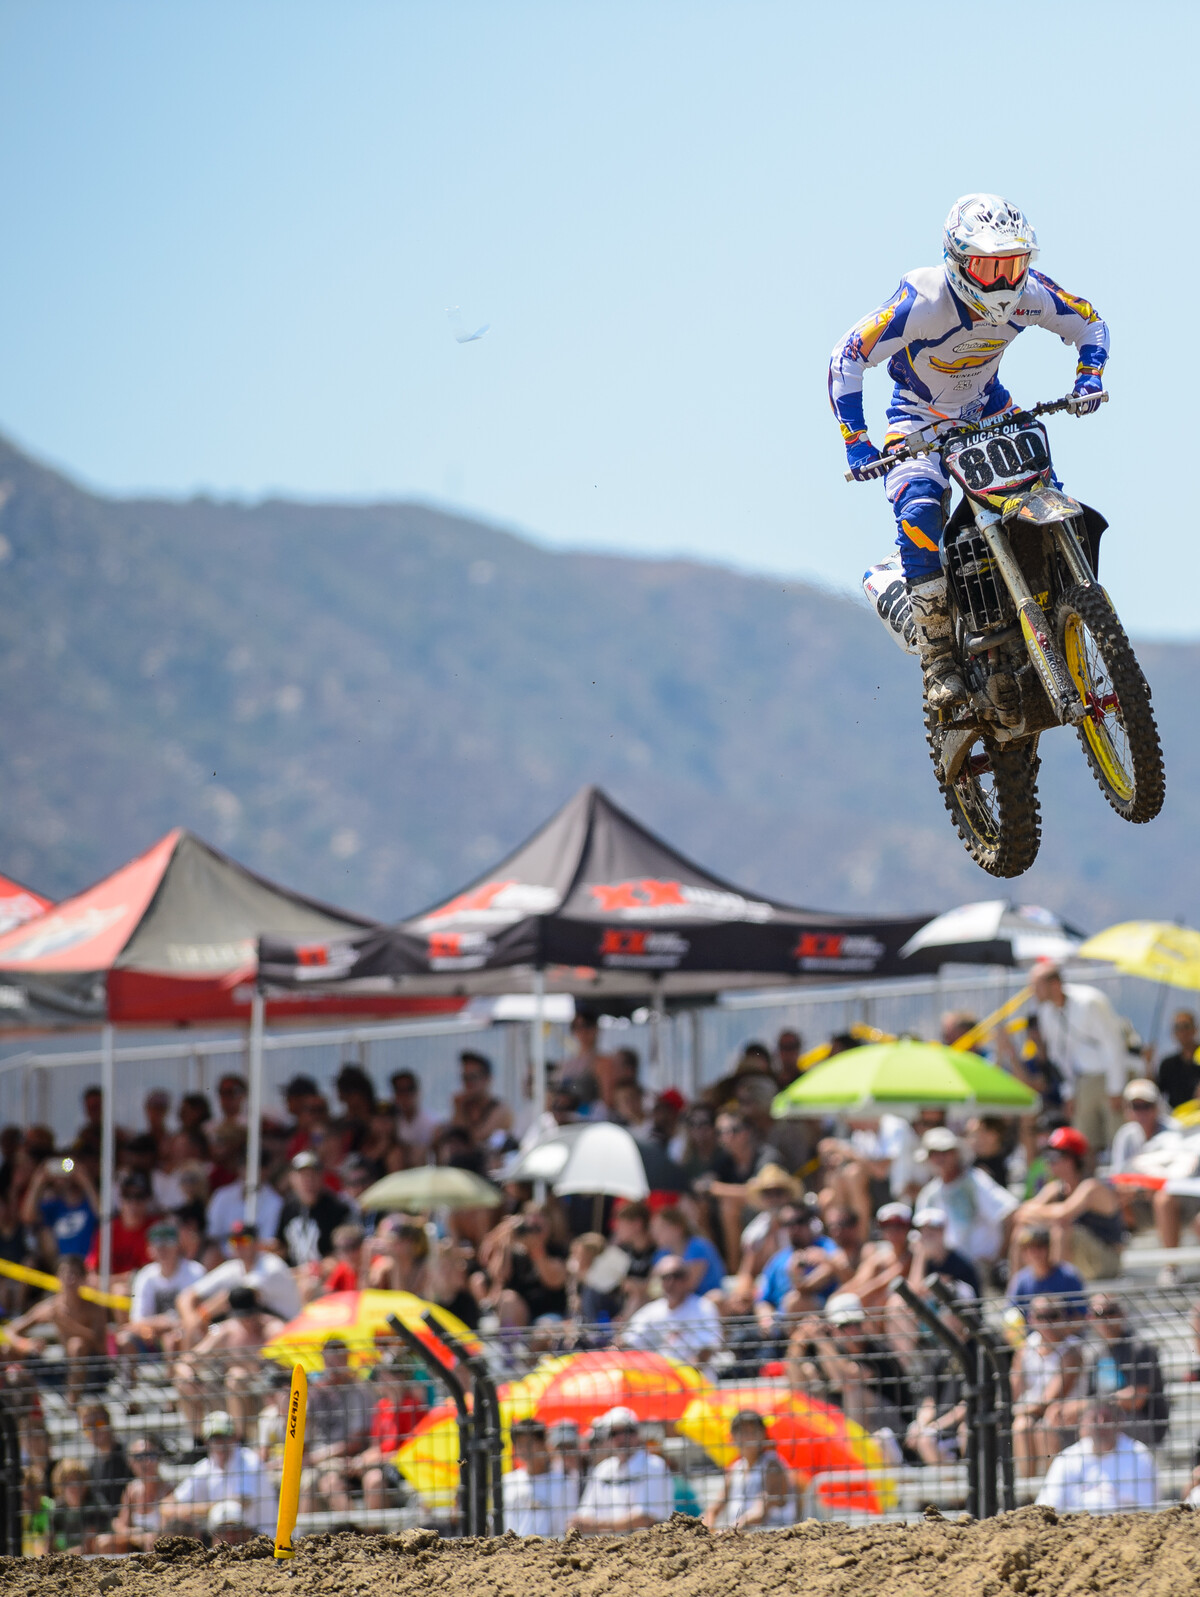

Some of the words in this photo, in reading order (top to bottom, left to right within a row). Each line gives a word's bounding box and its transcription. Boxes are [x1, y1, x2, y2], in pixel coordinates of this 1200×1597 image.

[949, 371, 982, 379] DUNLOP
[966, 427, 1000, 447] LUCAS
[1002, 423, 1020, 435] OIL
[958, 431, 1049, 491] 800
[1028, 638, 1060, 700] DUNLOP
[290, 1390, 300, 1439] ACERBIS
